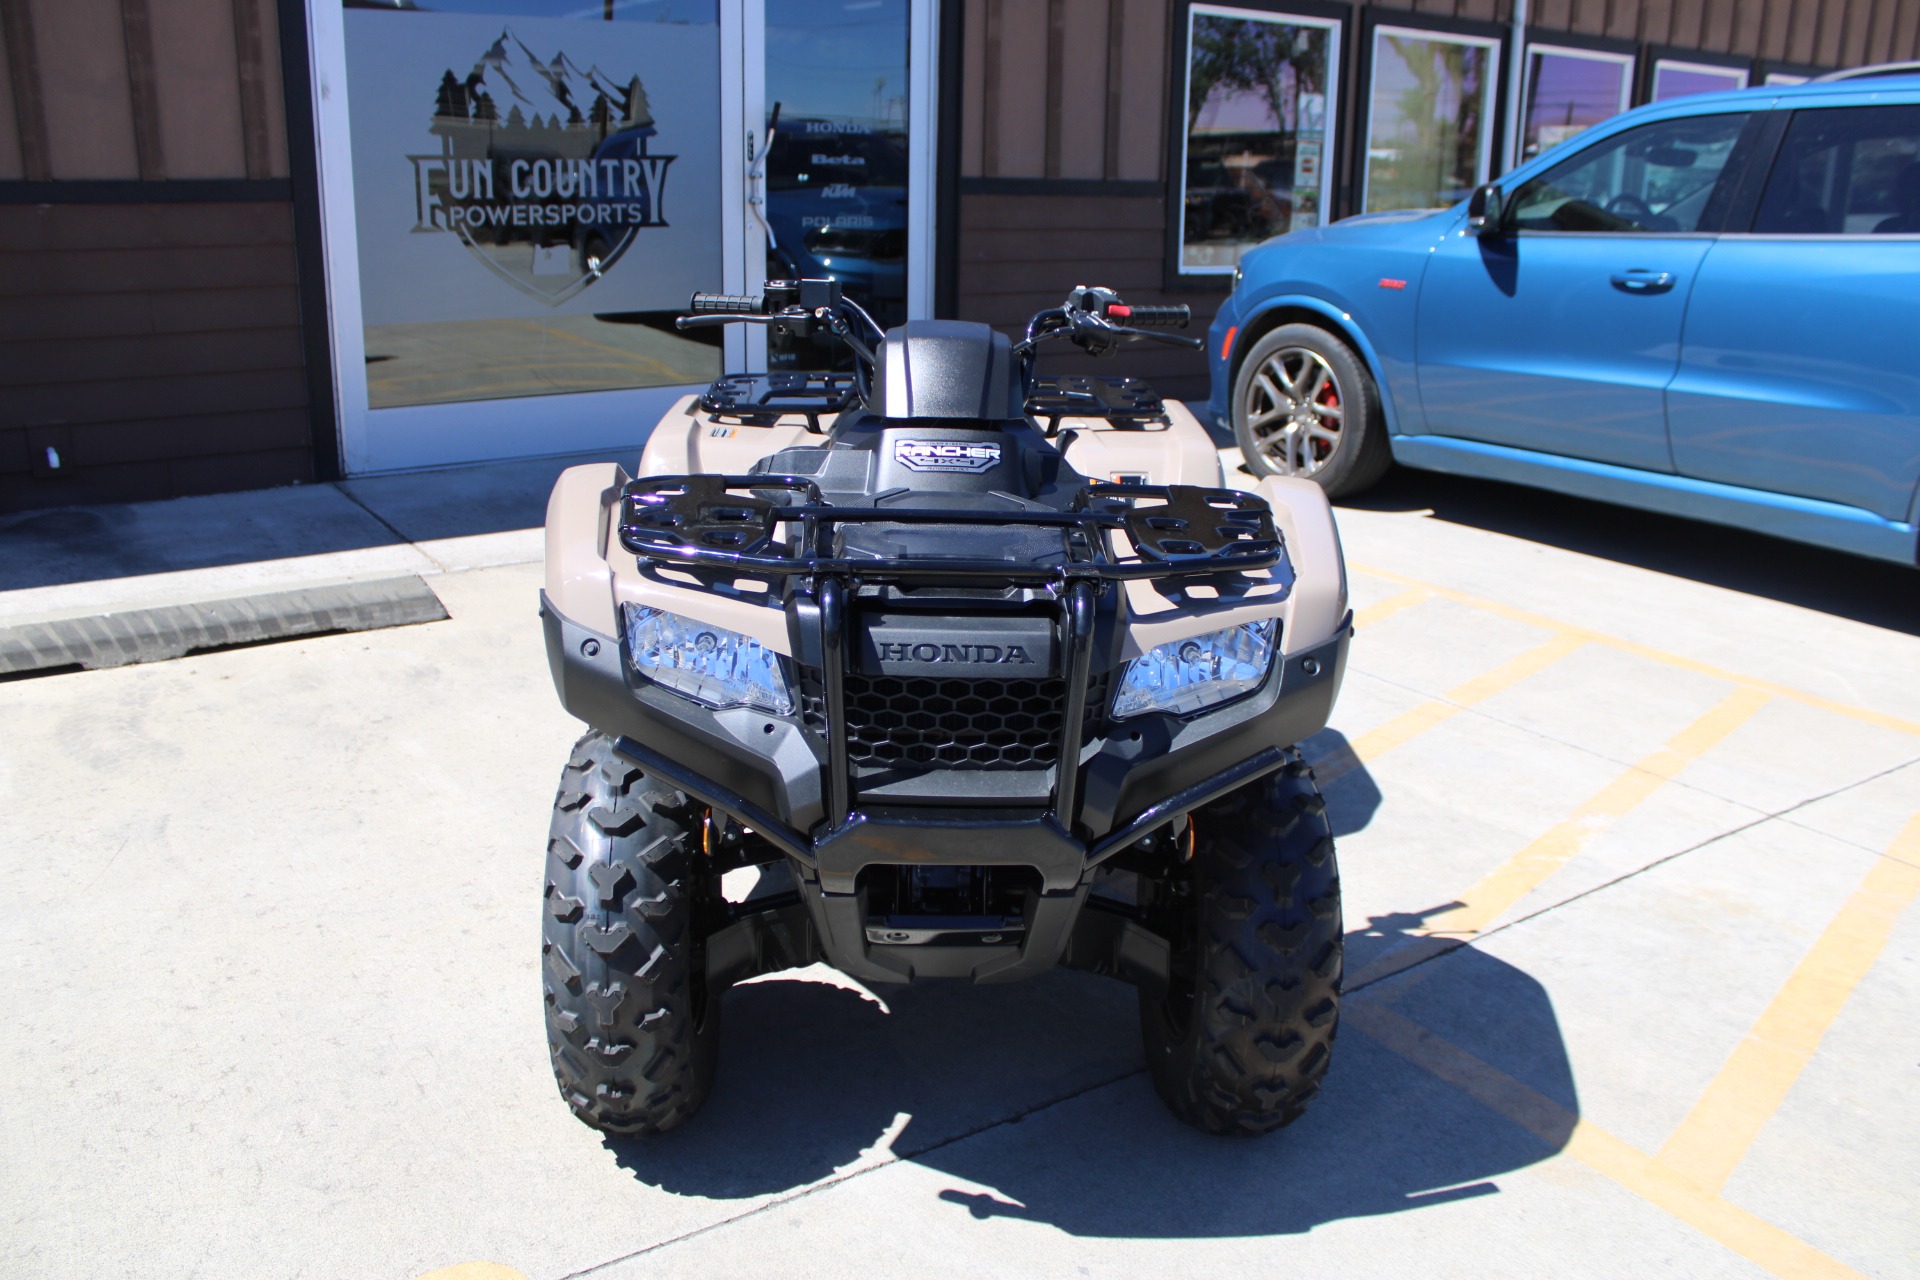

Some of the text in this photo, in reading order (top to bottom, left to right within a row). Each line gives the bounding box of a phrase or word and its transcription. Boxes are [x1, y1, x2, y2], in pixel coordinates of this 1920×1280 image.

[805, 121, 871, 134] HONDA
[811, 153, 866, 165] Beta
[416, 158, 667, 230] FUN COUNTRY
[821, 183, 856, 198] KTM
[451, 202, 642, 228] POWERSPORTS
[802, 216, 874, 228] POLARIS
[895, 445, 1001, 460] RANCHER
[879, 642, 1036, 664] HONDA
